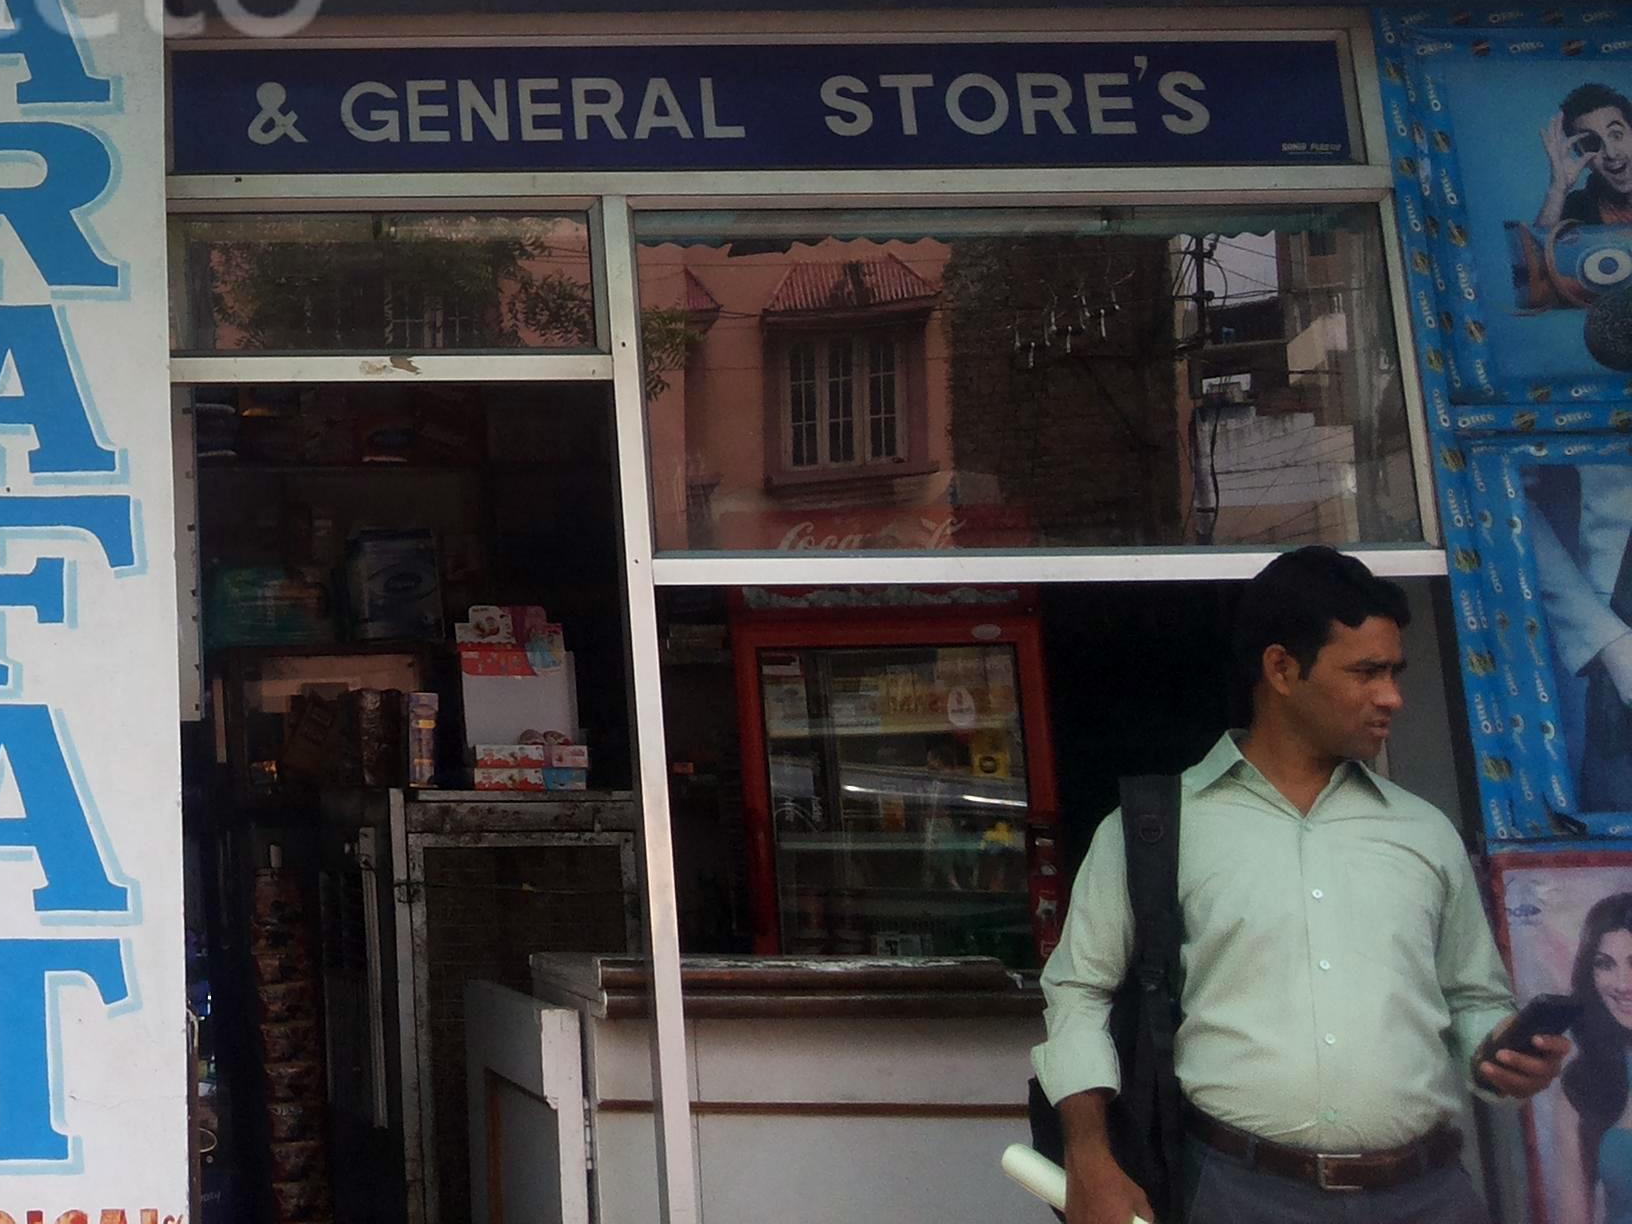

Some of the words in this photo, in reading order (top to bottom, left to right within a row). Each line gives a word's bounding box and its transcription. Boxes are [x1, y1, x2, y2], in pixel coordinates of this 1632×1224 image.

[248, 81, 308, 145] &
[340, 77, 746, 143] GENERAL
[820, 54, 1212, 137] STORE'S
